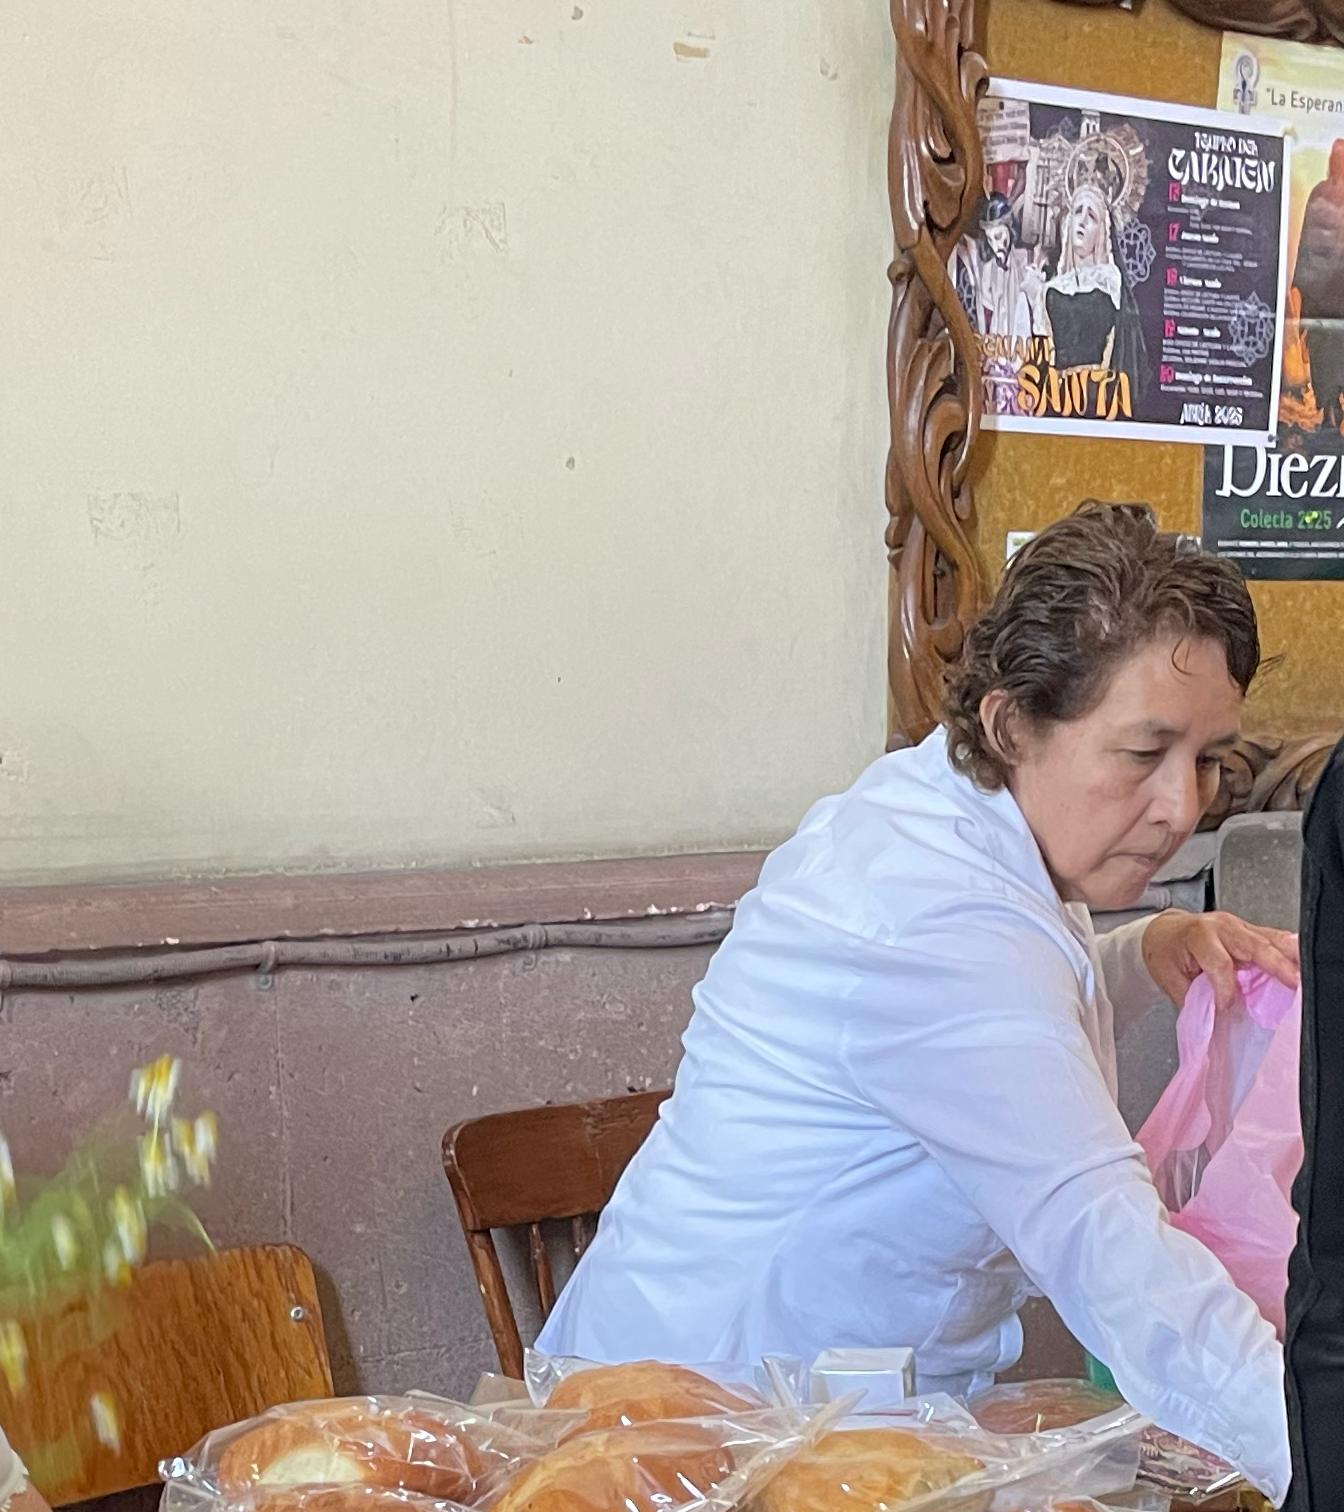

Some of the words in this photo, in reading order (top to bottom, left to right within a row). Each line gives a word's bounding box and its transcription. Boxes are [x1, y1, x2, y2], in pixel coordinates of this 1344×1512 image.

[1167, 147, 1276, 194] CARMEN
[1017, 363, 1133, 422] SANTA
[1240, 508, 1294, 529] Colecta
